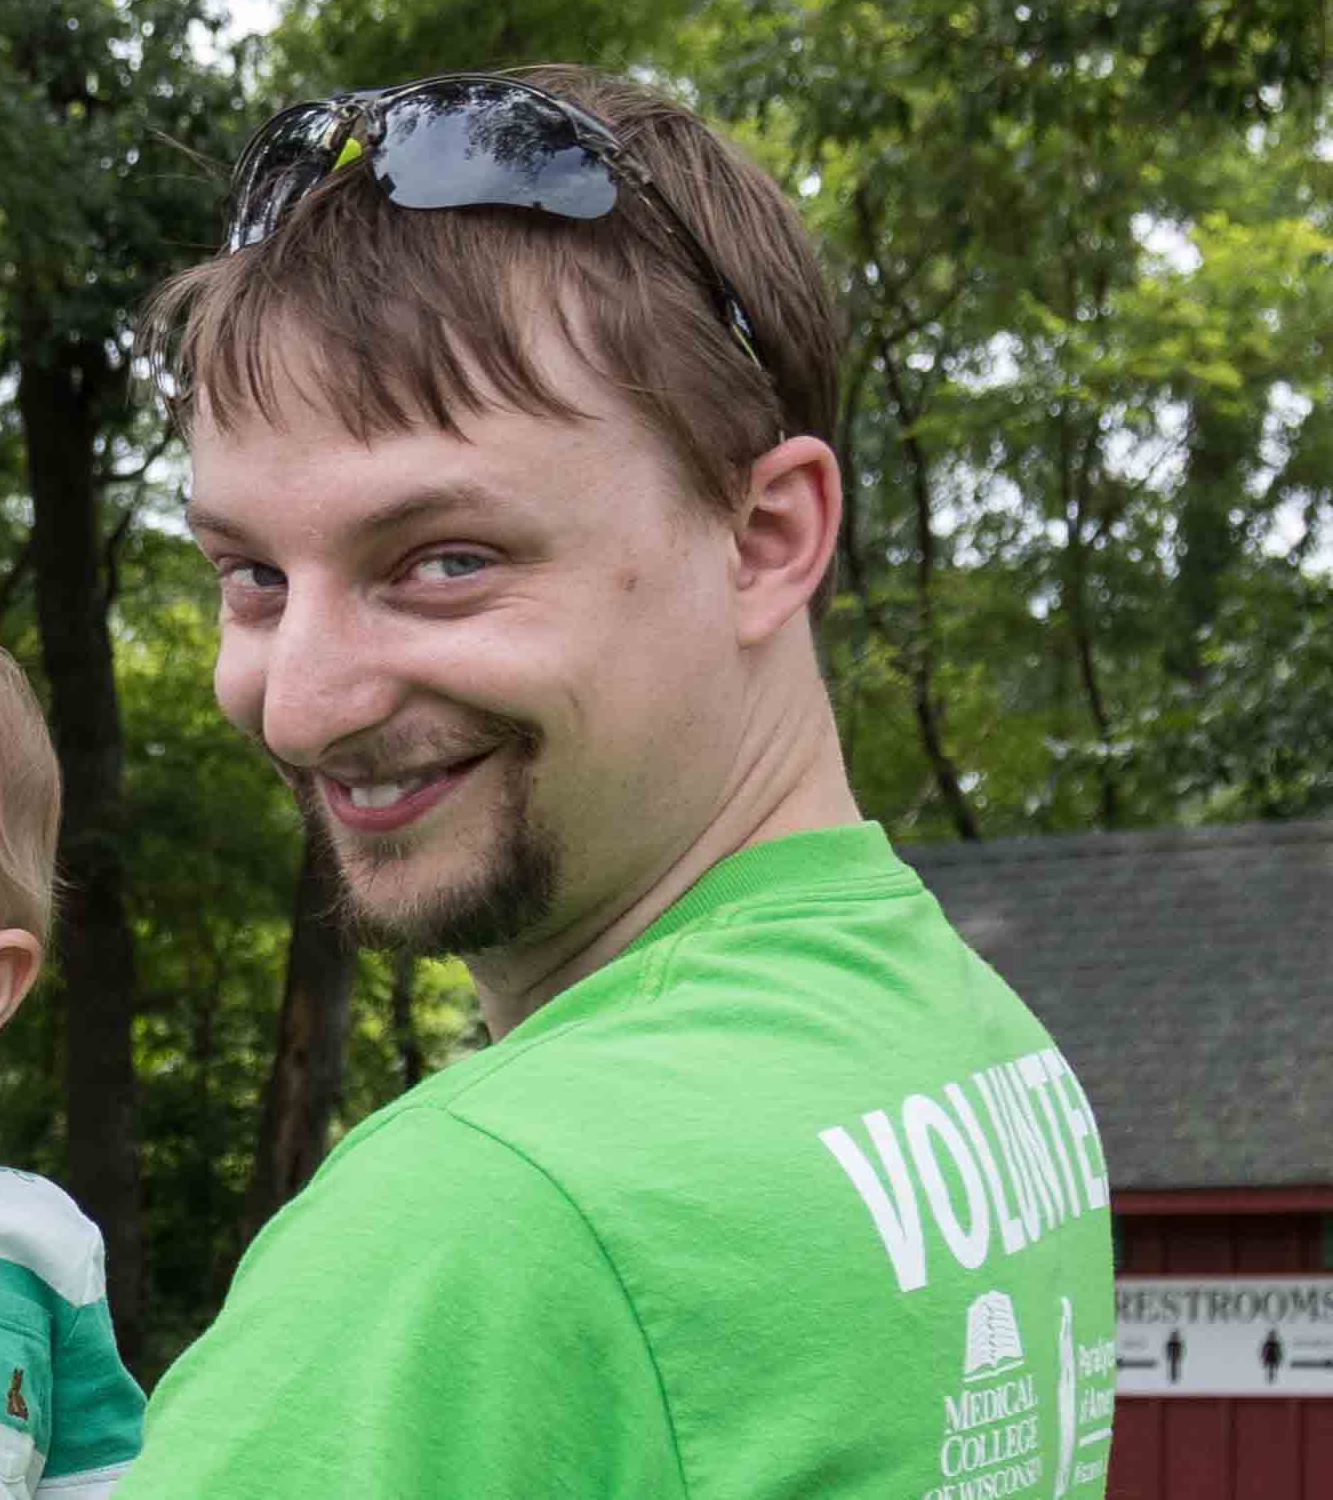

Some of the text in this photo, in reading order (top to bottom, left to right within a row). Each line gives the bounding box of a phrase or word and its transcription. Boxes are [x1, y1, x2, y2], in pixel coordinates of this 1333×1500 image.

[817, 1049, 1110, 1292] VOLUNTE
[944, 1375, 1038, 1433] MEDICAL
[941, 1412, 1038, 1477] COLLEGE
